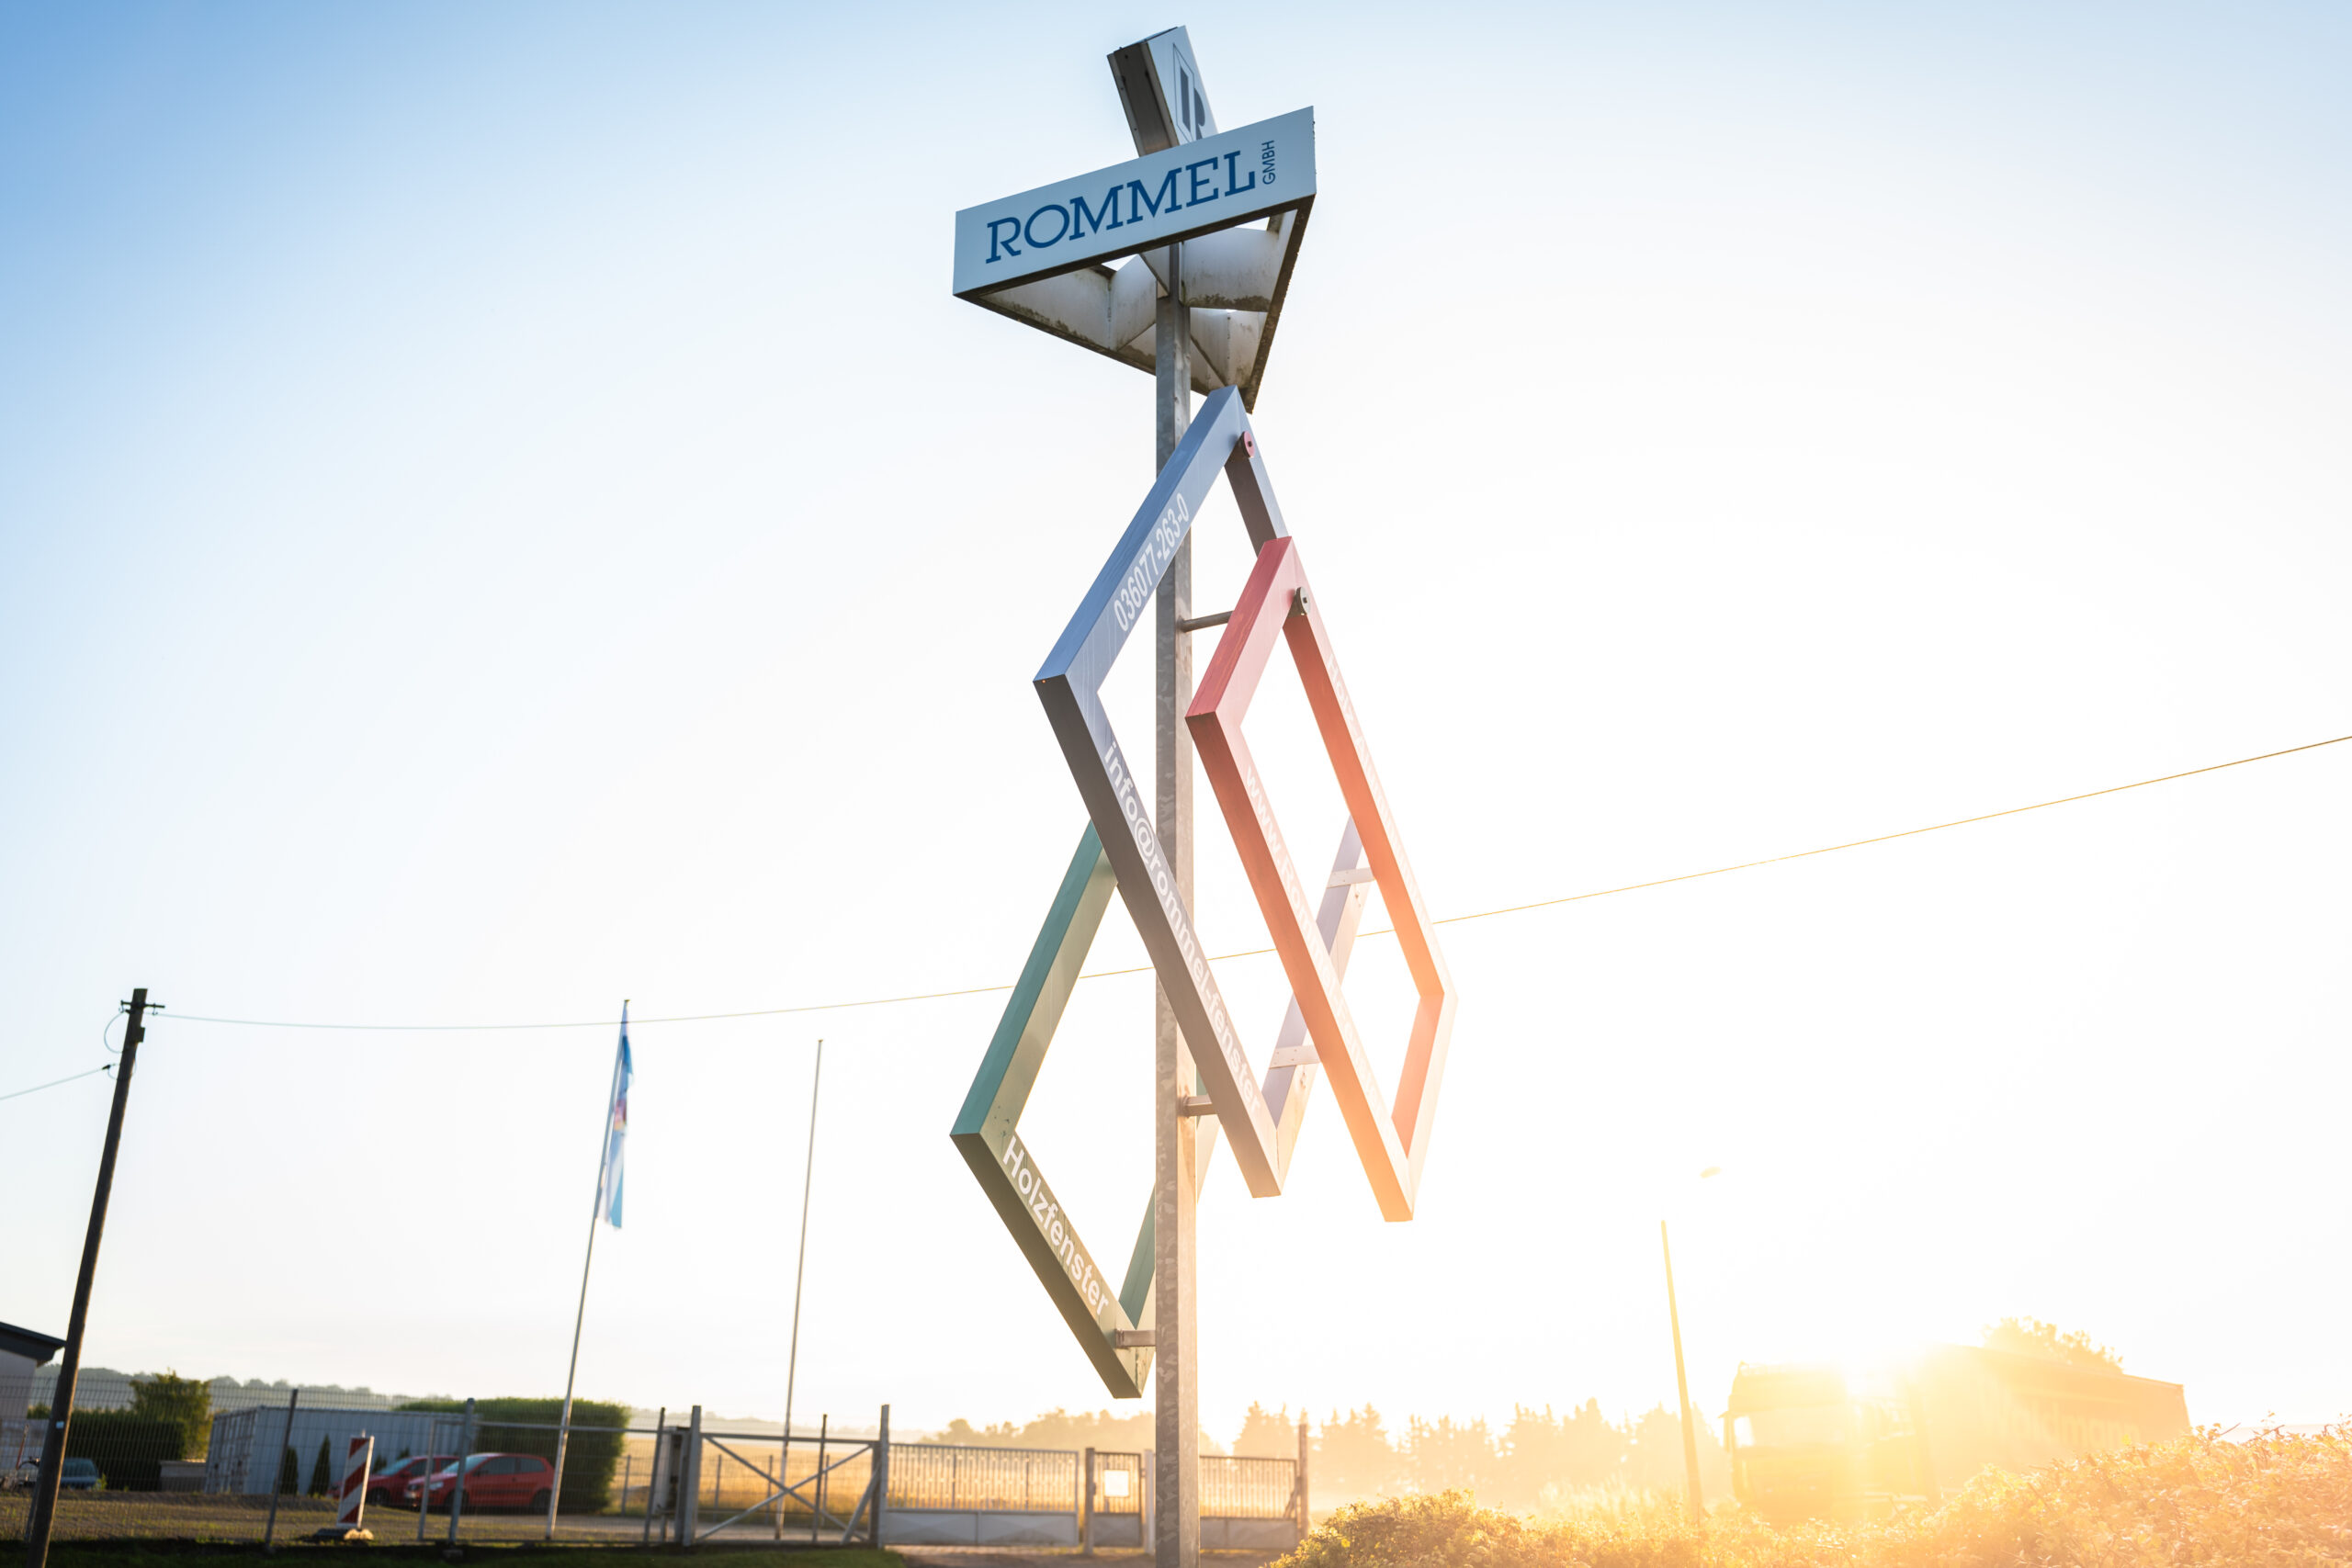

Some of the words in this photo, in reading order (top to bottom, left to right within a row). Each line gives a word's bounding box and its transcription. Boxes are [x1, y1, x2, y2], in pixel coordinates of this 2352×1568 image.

[985, 151, 1256, 264] ROMMEL
[1262, 140, 1275, 185] GMBH
[1114, 492, 1190, 632] 036077-263-0
[1104, 741, 1261, 1114] info@rommel-fenster
[1002, 1135, 1109, 1315] Holzfenster
